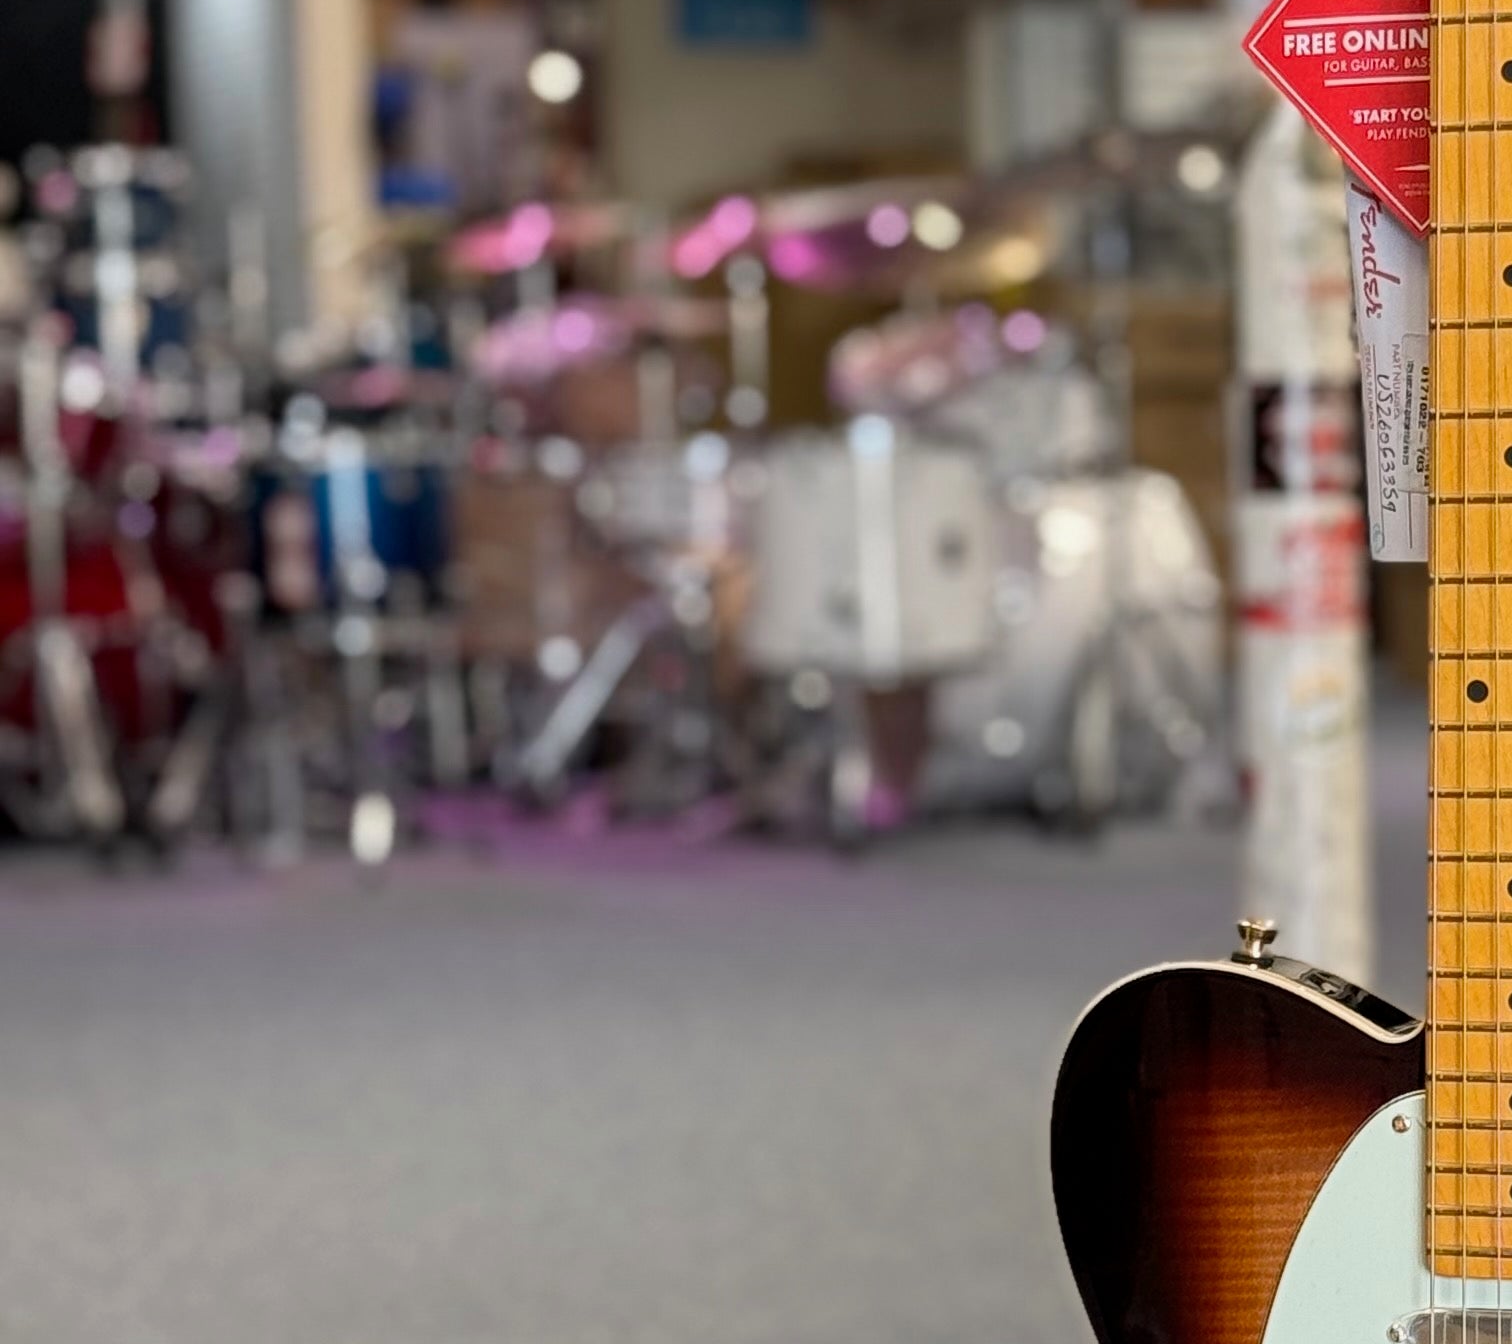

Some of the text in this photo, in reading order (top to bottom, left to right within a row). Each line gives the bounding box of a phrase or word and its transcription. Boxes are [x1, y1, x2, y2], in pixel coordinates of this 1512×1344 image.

[1283, 27, 1429, 57] FREE ONLIN
[1324, 56, 1430, 73] FOR GUITAR, BAS
[1400, 107, 1431, 121] YOU
[1367, 126, 1431, 141] PLAY.FEND
